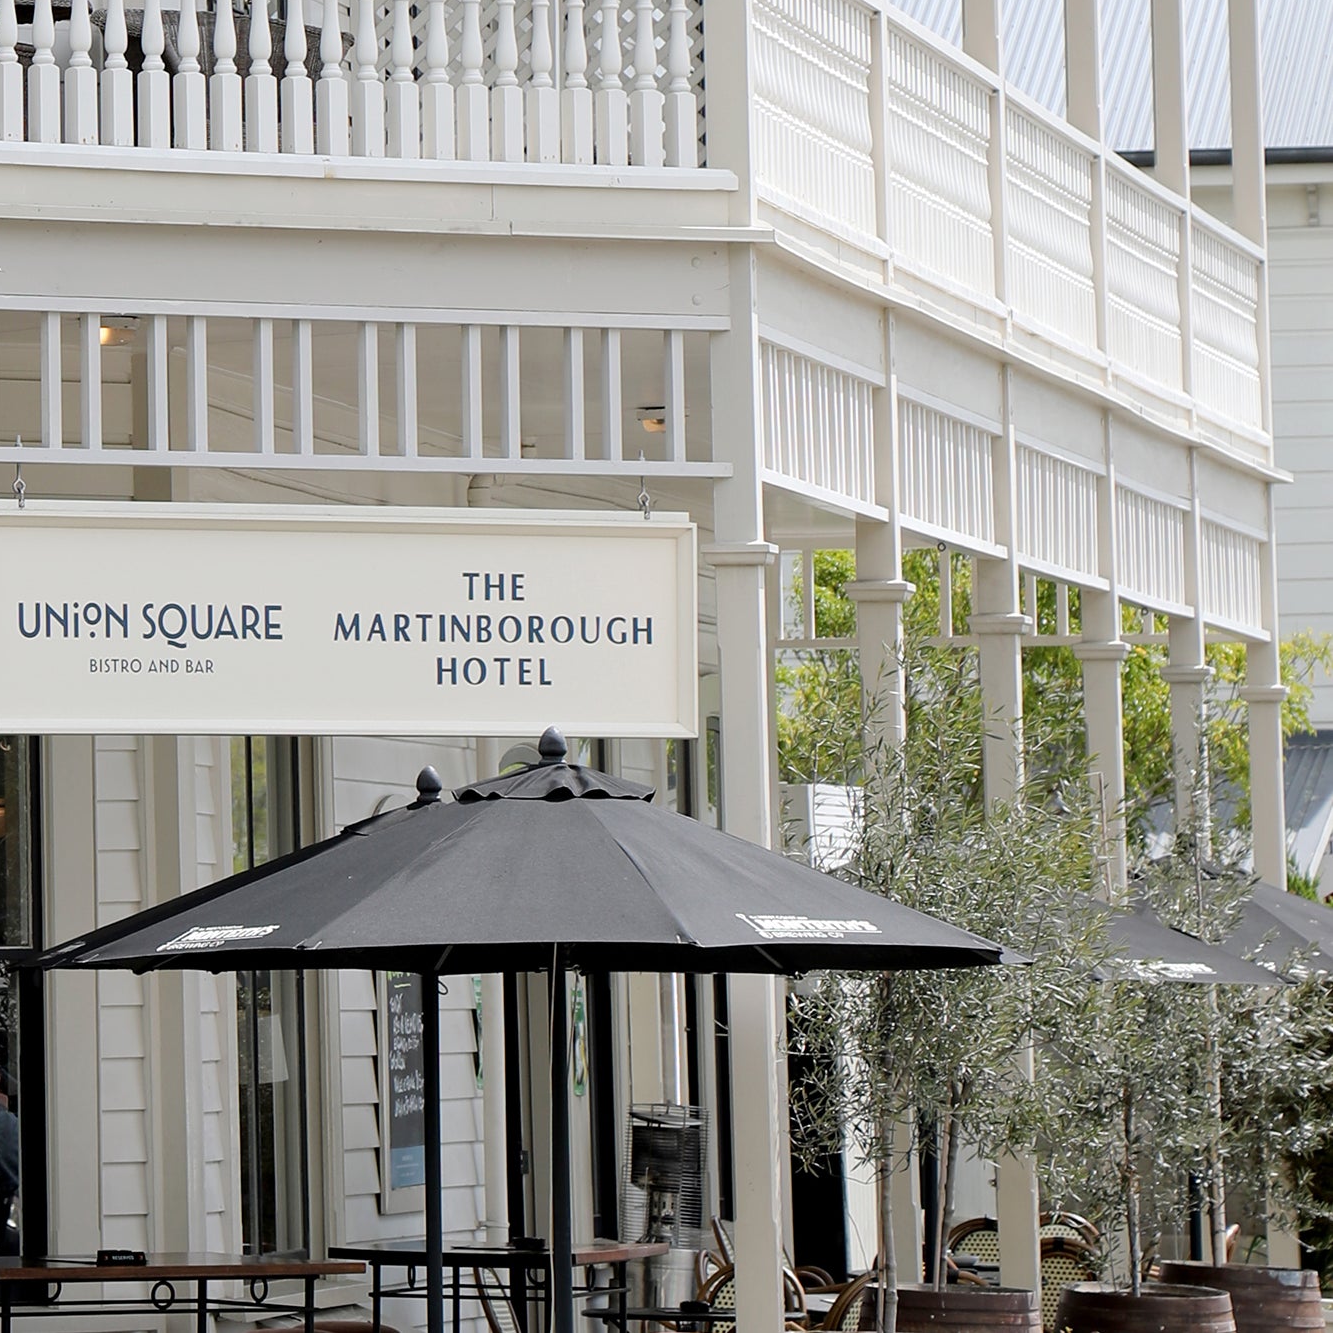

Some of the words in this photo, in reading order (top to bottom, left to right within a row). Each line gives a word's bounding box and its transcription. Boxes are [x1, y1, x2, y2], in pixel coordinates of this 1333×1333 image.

[462, 572, 525, 601] THE
[142, 603, 283, 649] SQUARE
[333, 612, 654, 645] MARTINBOROUGH
[89, 658, 142, 673] BISTRO
[148, 659, 180, 673] AND
[185, 659, 214, 674] BAR
[436, 657, 552, 686] HOTEL
